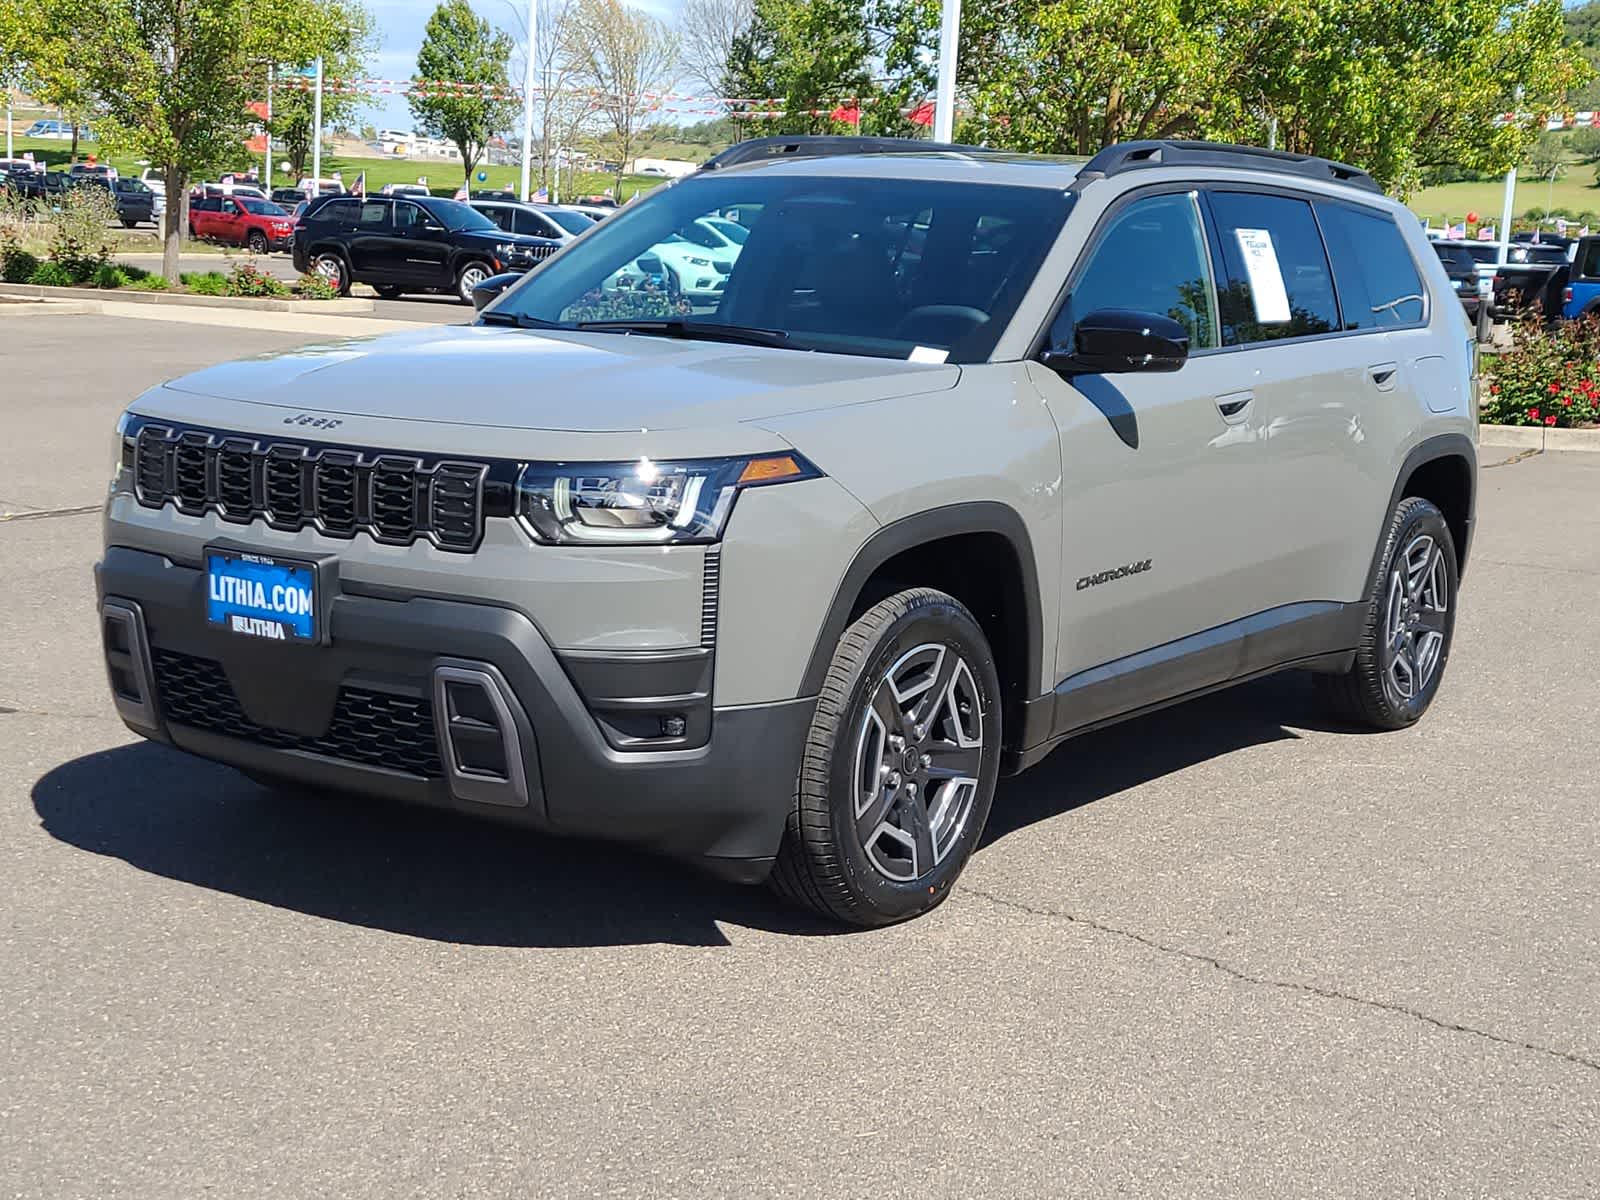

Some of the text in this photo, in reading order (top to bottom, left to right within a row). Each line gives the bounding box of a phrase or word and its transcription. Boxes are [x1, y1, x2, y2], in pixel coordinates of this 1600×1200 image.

[283, 413, 343, 430] Jeep
[1076, 558, 1153, 591] CHEROKEE
[209, 573, 314, 617] LITHIA.COM
